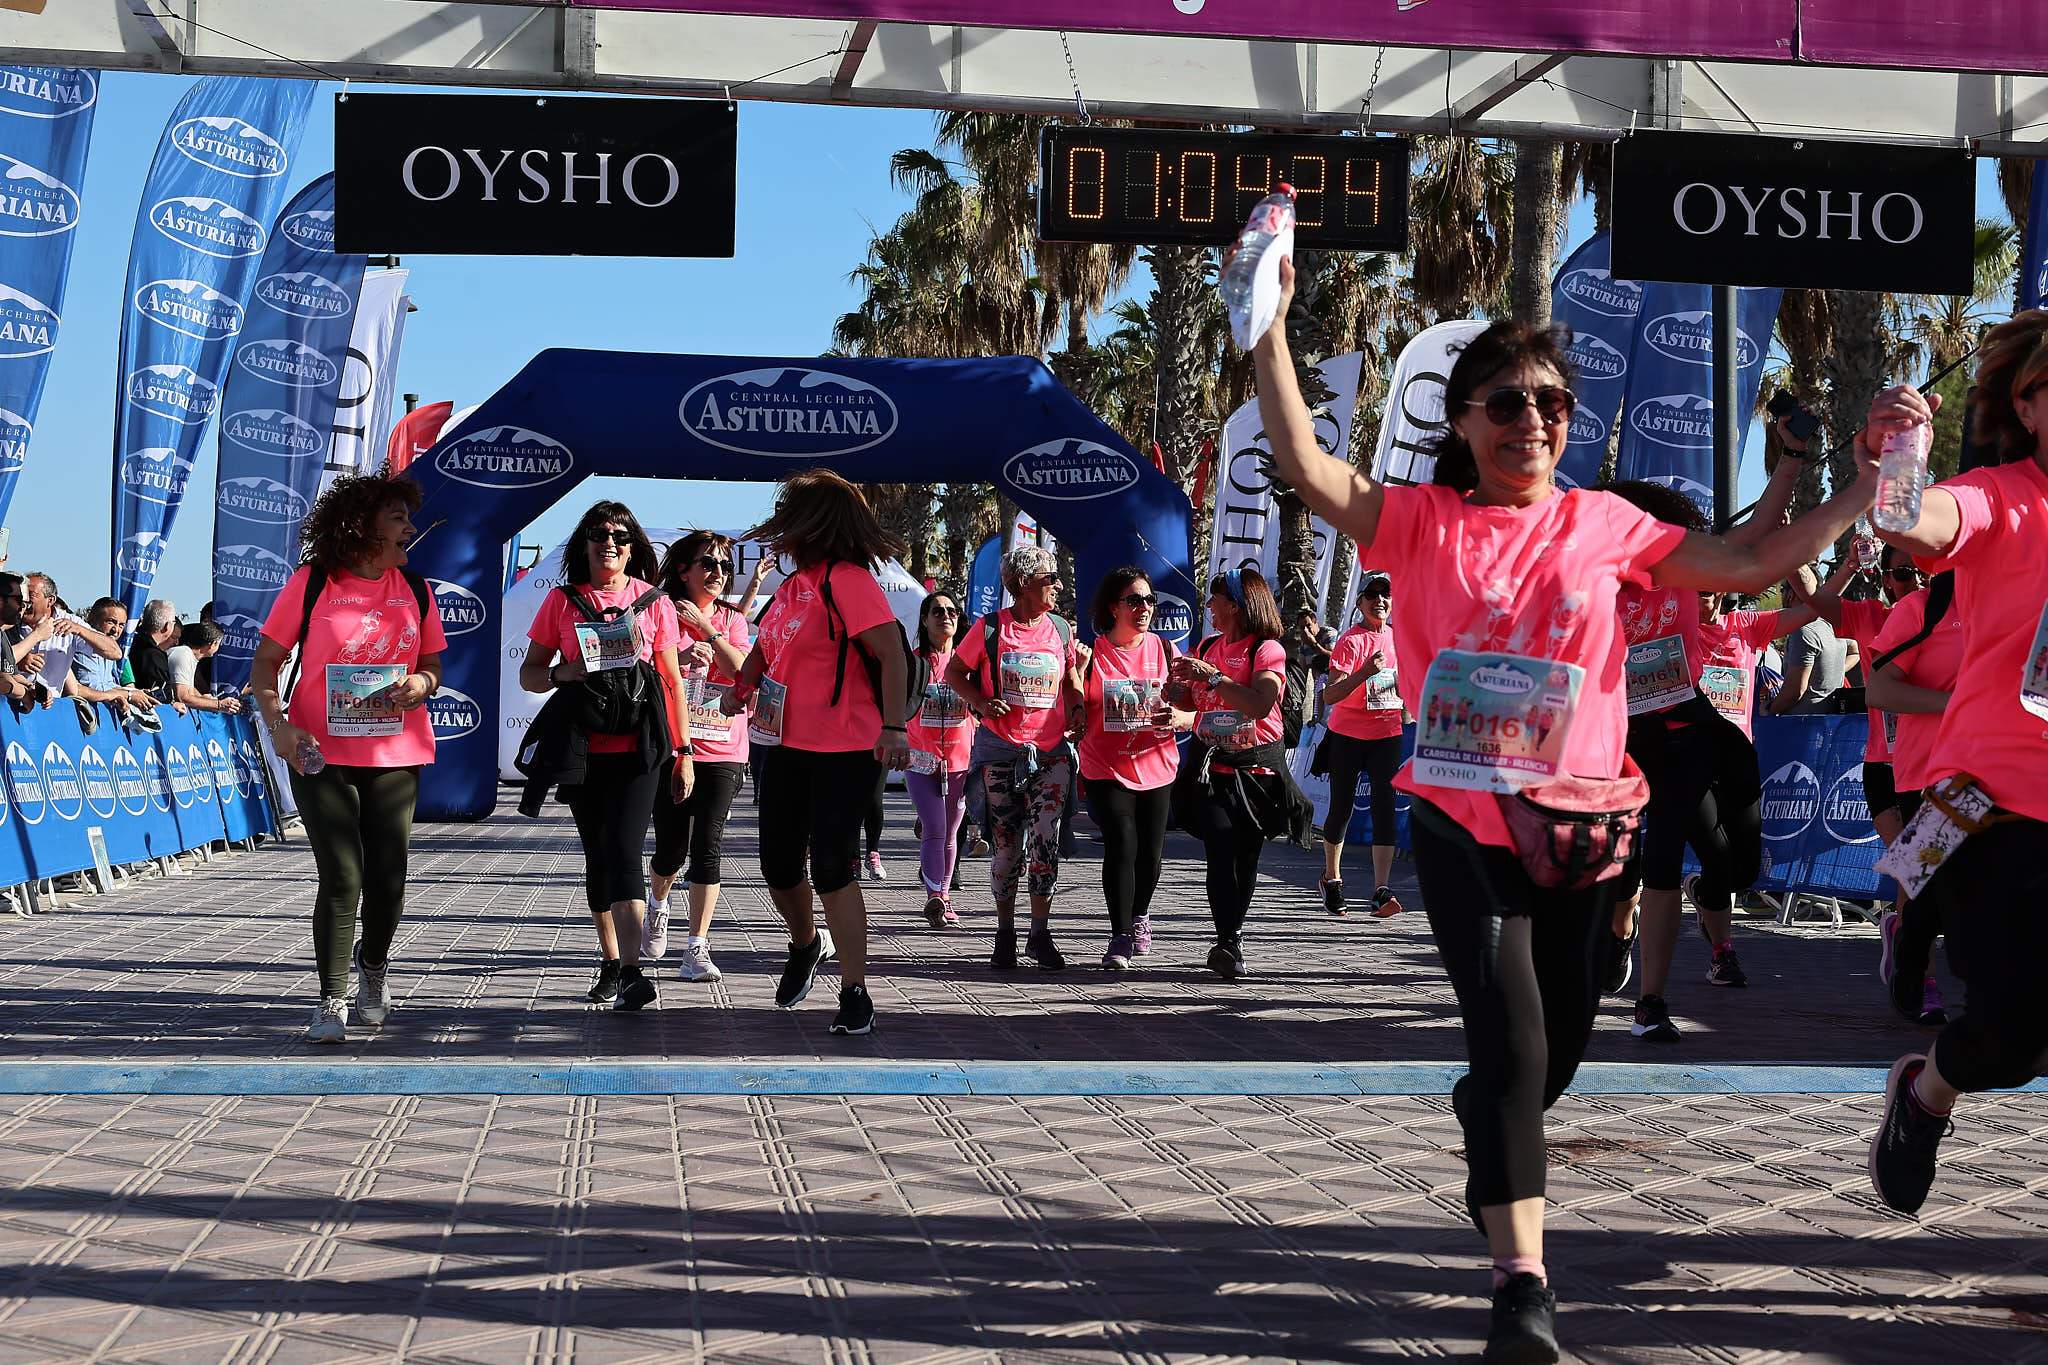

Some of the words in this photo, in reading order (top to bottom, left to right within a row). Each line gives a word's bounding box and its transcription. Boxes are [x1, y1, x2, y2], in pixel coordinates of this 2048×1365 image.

[0, 70, 83, 105] URIANA
[201, 128, 238, 144] CENTRAL
[178, 126, 279, 173] ASTURIANA
[402, 146, 680, 207] OYSHO
[9, 184, 65, 201] LECHERA
[180, 208, 217, 225] CENTRAL
[1673, 183, 1924, 244] OYSHO
[157, 206, 259, 251] ASTURIANA
[260, 281, 343, 314] ASTURIANA
[1564, 275, 1640, 312] ASTURIANA
[0, 308, 48, 324] ECHERA
[142, 289, 238, 332] ASTURIANA
[1672, 324, 1711, 336] CENTRAL
[243, 348, 329, 382] ASTURIANA
[730, 392, 799, 403] CENTRAL
[806, 394, 875, 405] LECHERA
[695, 392, 882, 435] ASTURIANA
[1638, 407, 1713, 437] ASTURIA
[1656, 408, 1693, 420] CENTRAL
[229, 418, 315, 451] ASTURIANA
[466, 446, 511, 454] CENTRAL
[515, 448, 561, 456] LECHERA
[443, 447, 562, 474] ASTURIANA
[1032, 458, 1078, 467] CENTRAL
[1015, 462, 1132, 486] ASTURIANA
[219, 487, 301, 518] ASTURIANA
[219, 563, 287, 585] STURIANA
[879, 582, 909, 593] SHO
[438, 598, 476, 607] LECHERA
[1020, 676, 1042, 687] 016
[1472, 671, 1530, 691] ASTURIANA
[1641, 671, 1666, 685] 016
[352, 697, 382, 709] 016
[1710, 691, 1731, 702] 016
[432, 702, 472, 710] LECHERA
[696, 706, 719, 718] 016
[506, 717, 532, 729] OYS
[1469, 713, 1521, 738] 016
[1476, 741, 1502, 754] 1636
[1423, 749, 1461, 760] CARRERA
[1462, 753, 1472, 762] DE
[1473, 755, 1482, 764] LA
[1483, 756, 1510, 767] MUJER
[1512, 759, 1549, 773] VALENCIA
[1429, 765, 1477, 781] OYSHO
